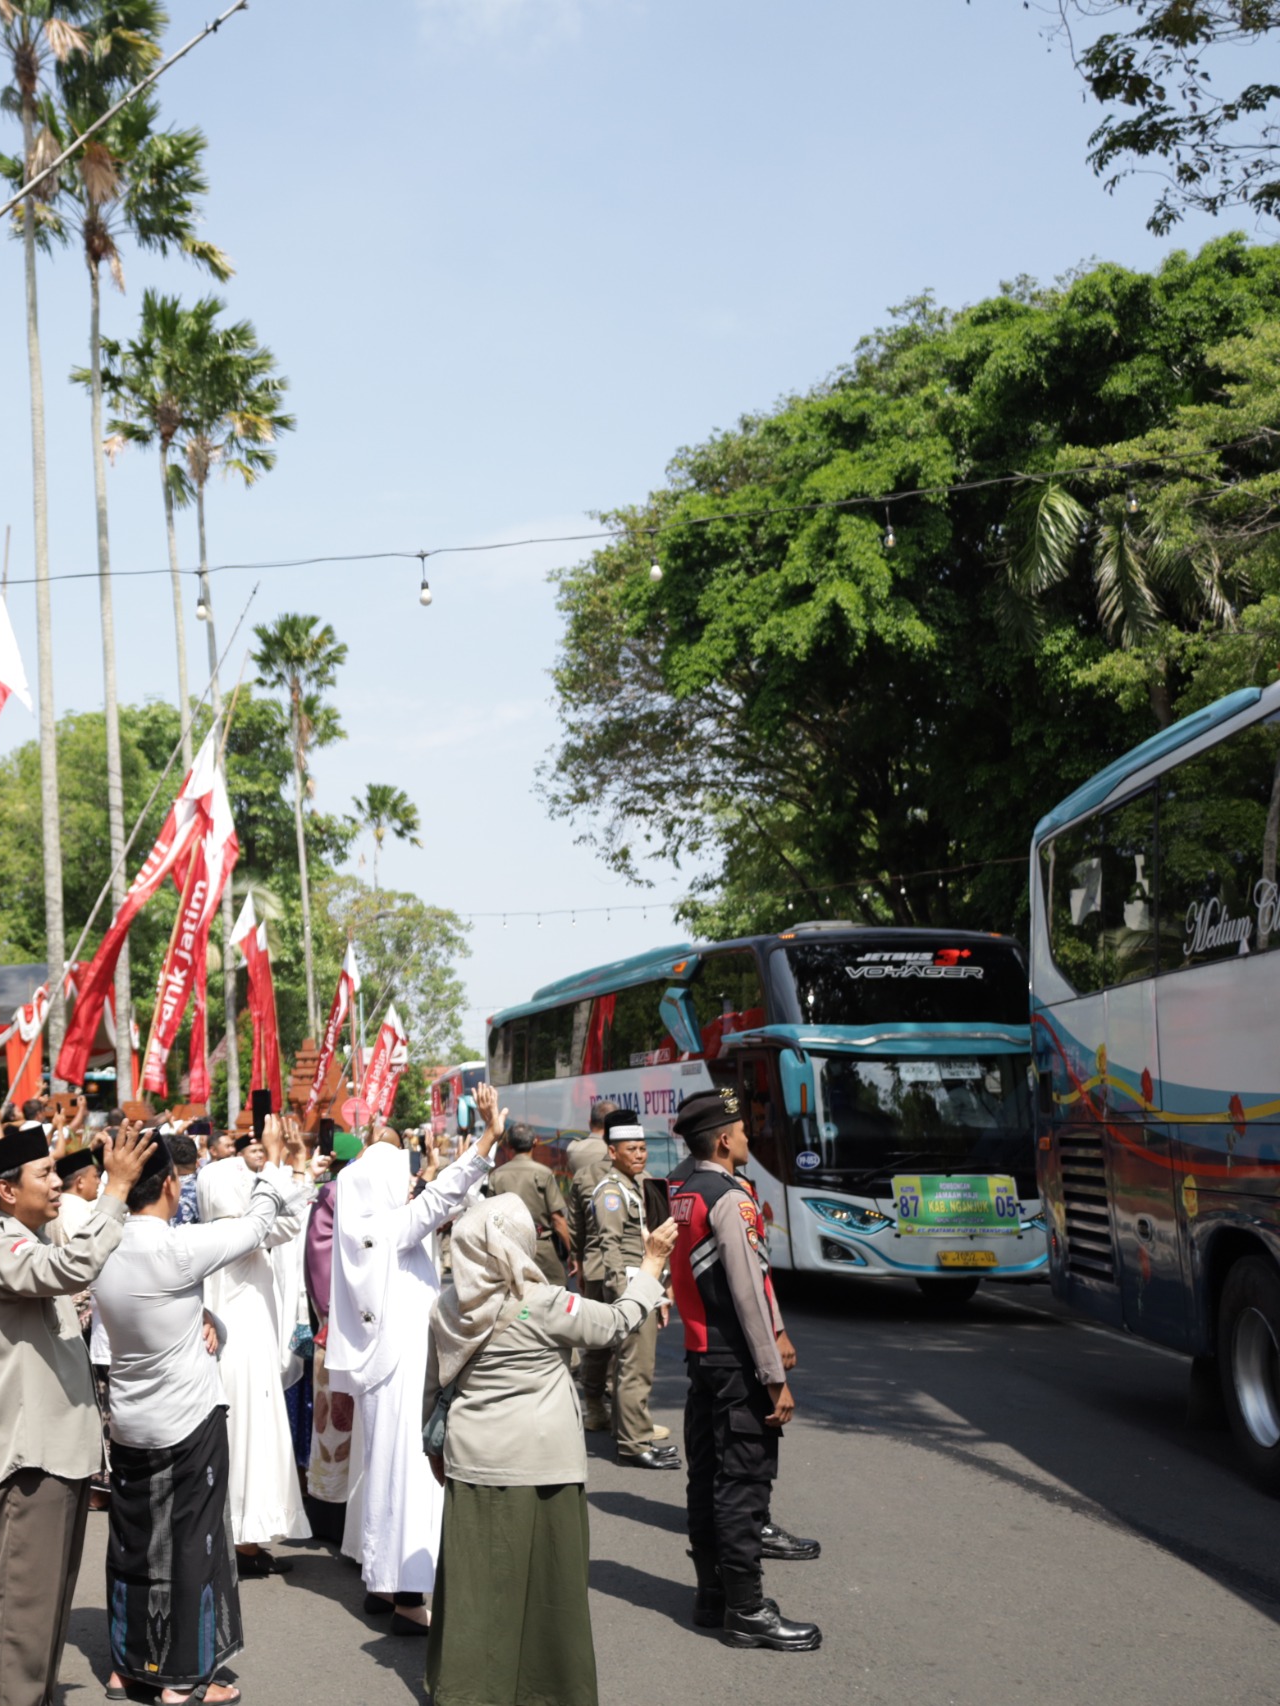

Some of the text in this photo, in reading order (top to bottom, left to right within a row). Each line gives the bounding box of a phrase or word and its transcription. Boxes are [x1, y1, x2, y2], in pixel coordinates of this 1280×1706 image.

[175, 879, 207, 966] jatim
[1183, 897, 1253, 955] Medium
[856, 952, 934, 962] JETBUS
[845, 965, 984, 979] VOYAGER
[590, 1088, 684, 1115] PAMA PUTRA
[670, 1198, 694, 1220] OLISI
[899, 1195, 919, 1218] 87
[928, 1200, 989, 1214] KAB. NGANJUK
[995, 1195, 1016, 1218] 05
